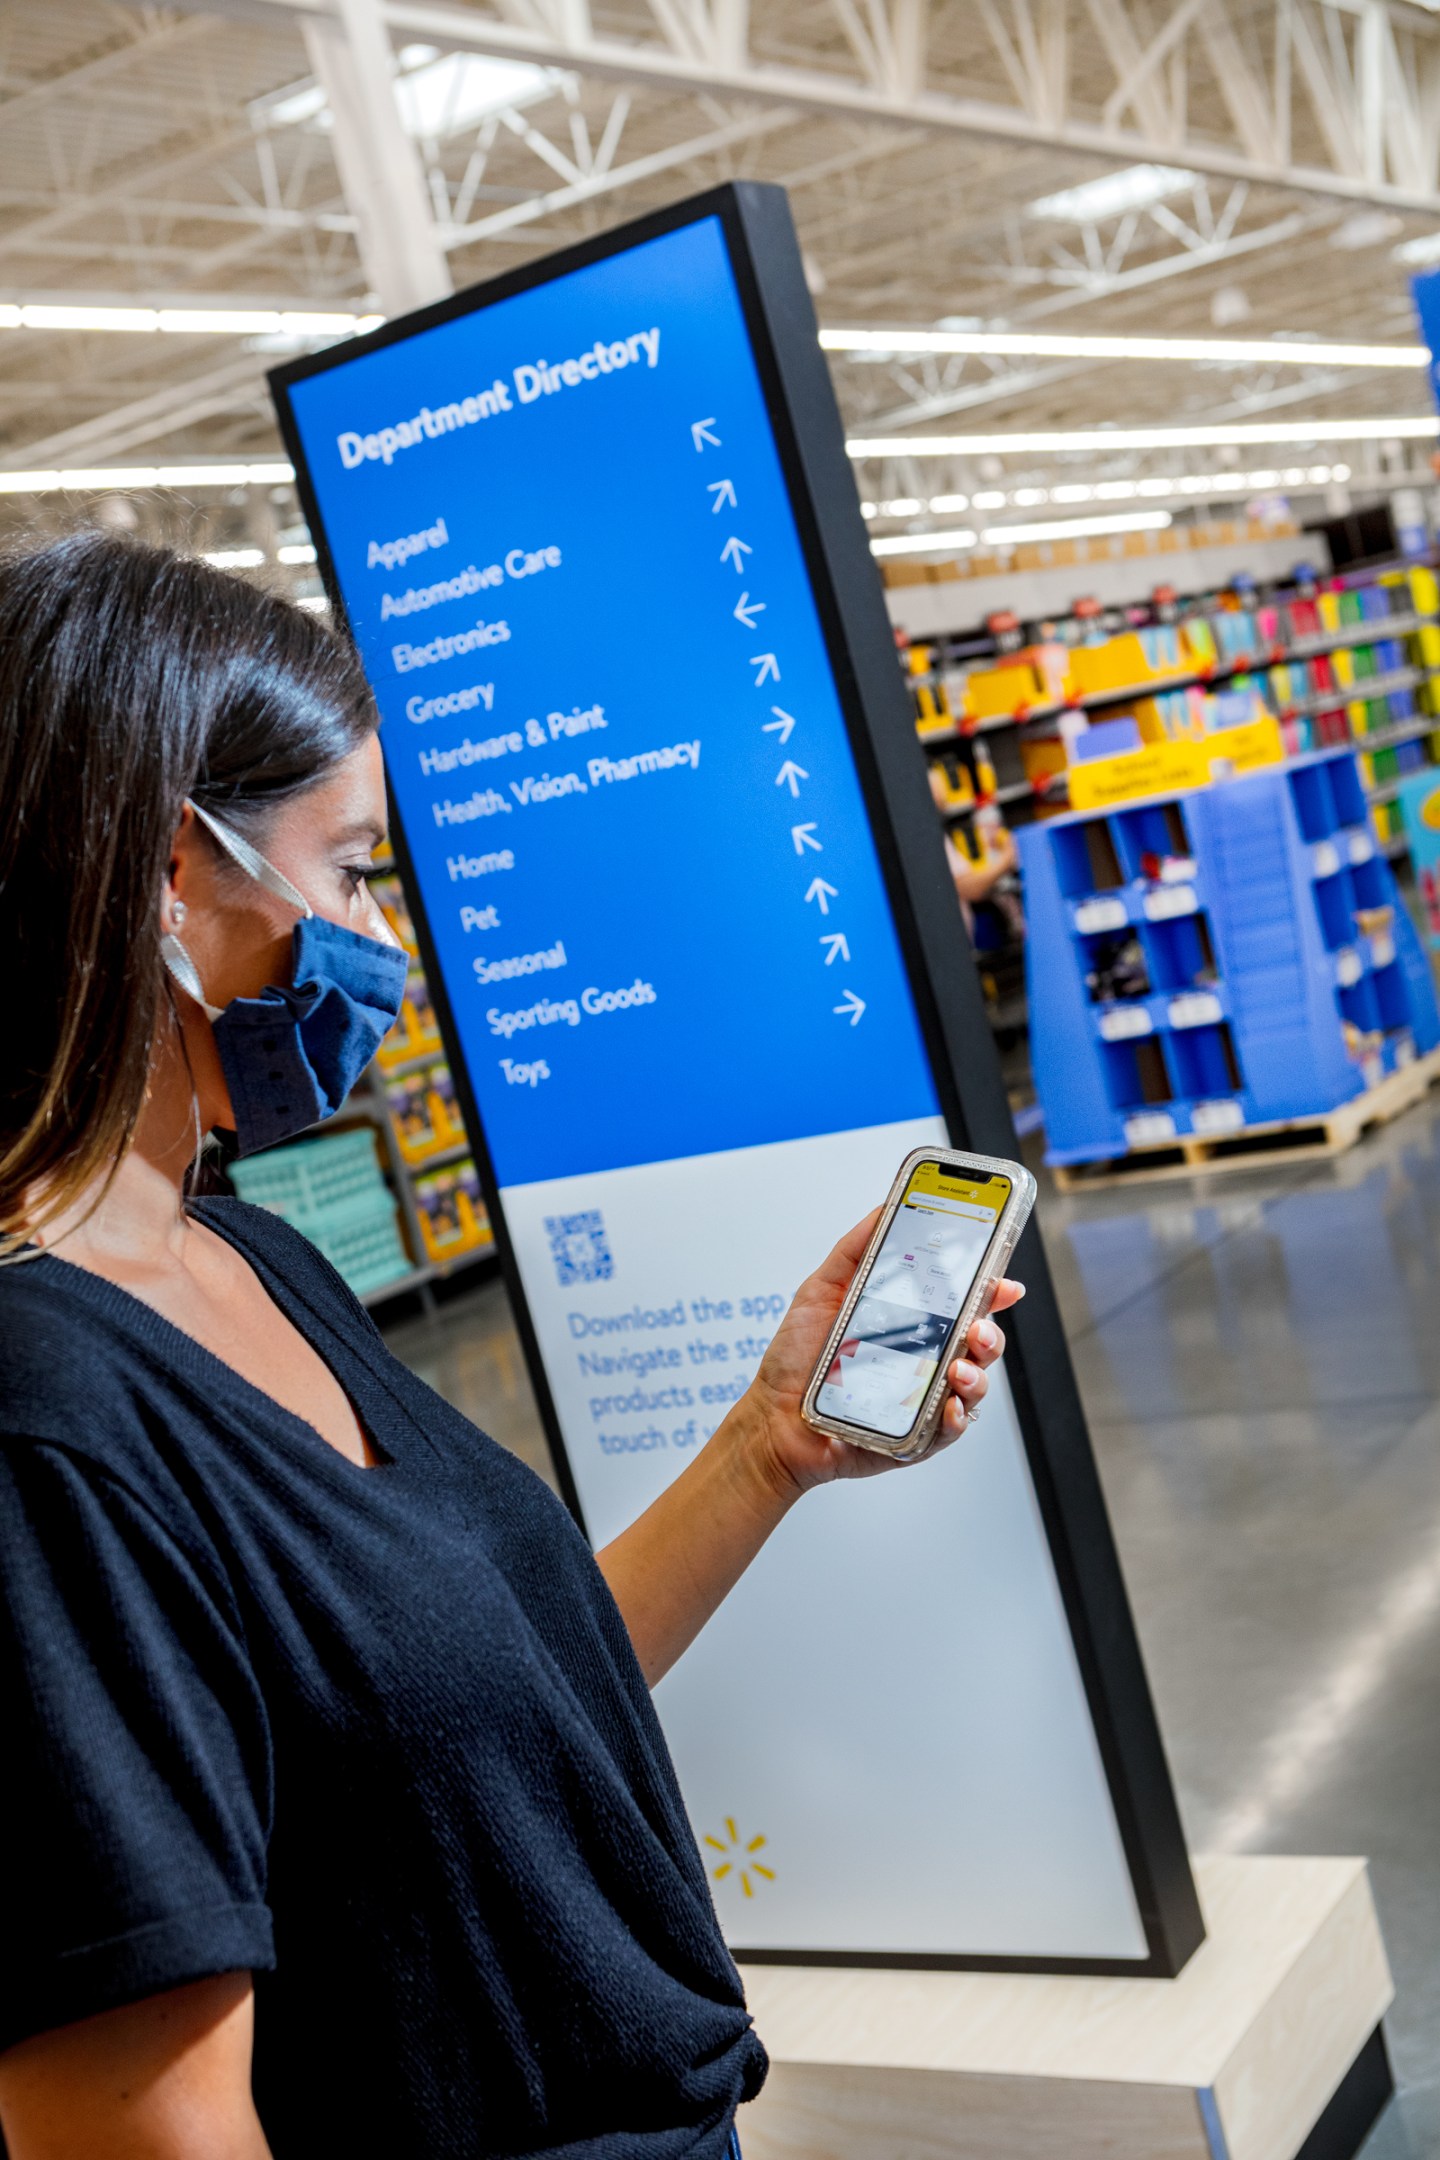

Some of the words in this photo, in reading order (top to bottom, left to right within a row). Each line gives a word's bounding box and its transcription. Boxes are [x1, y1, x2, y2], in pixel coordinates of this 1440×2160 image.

[338, 380, 512, 468] Department
[514, 328, 659, 403] Directory
[367, 518, 449, 570] Apparel
[382, 565, 503, 620] Automotive
[505, 546, 561, 578] Care
[392, 621, 511, 673] Electronics
[406, 683, 494, 723] Grocery
[419, 732, 522, 775] Hardware
[526, 719, 547, 747] &
[547, 704, 607, 740] Paint
[432, 787, 512, 826] Health,
[511, 773, 587, 805] Vision,
[588, 739, 701, 786] Pharmacy
[447, 850, 514, 881] Home
[460, 905, 500, 932] Pet
[473, 940, 567, 984] Seasonal
[487, 998, 580, 1038] Sporting
[581, 978, 656, 1015] Goods
[499, 1059, 550, 1088] Toys
[567, 1301, 687, 1339] Download
[691, 1296, 733, 1323] the
[740, 1294, 785, 1322] app
[578, 1348, 682, 1379] Navigate
[687, 1338, 729, 1365] the
[735, 1336, 771, 1359] sto
[590, 1386, 694, 1422] products
[599, 1424, 666, 1456] touch
[672, 1419, 699, 1448] of
